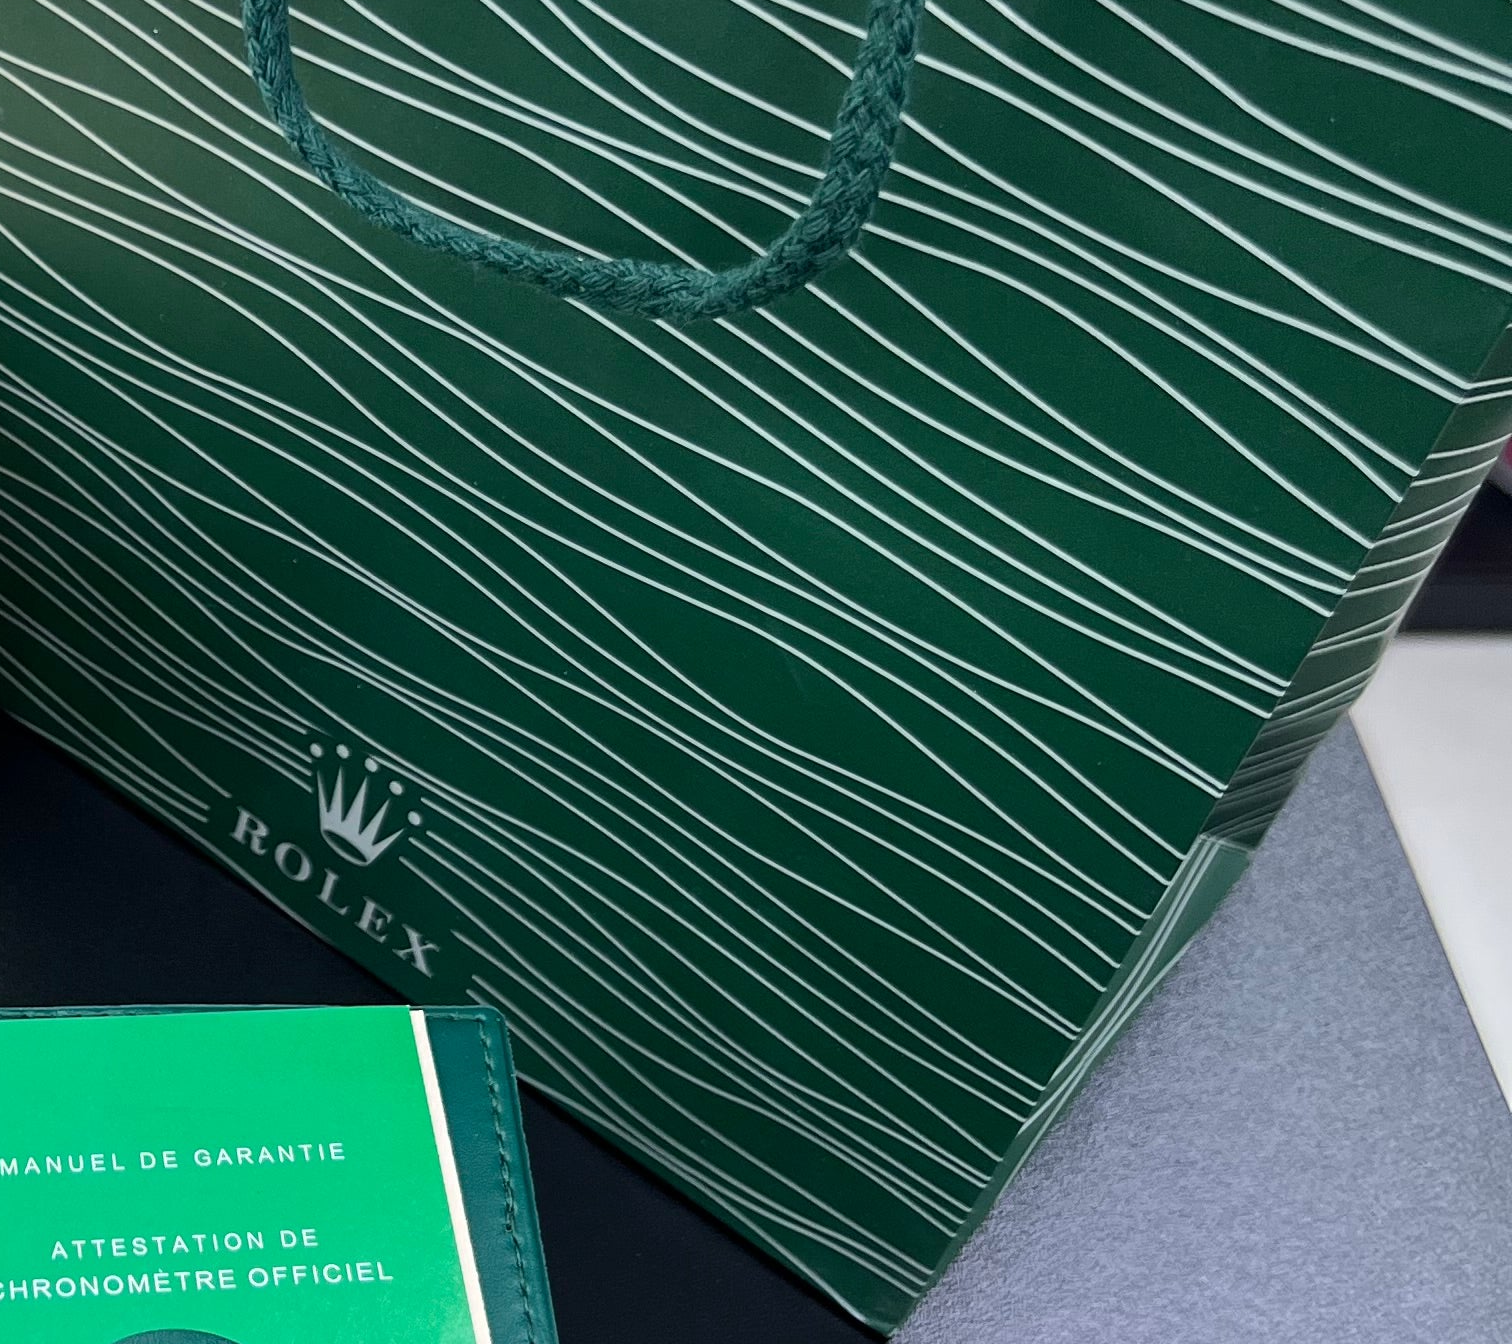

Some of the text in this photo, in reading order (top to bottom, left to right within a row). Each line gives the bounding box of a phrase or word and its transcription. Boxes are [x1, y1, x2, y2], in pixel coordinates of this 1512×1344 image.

[228, 806, 440, 979] ROLEX
[139, 1149, 178, 1171] DE
[193, 1142, 346, 1168] GARANTIE
[51, 1227, 319, 1260] ATTESTATION DE
[248, 1260, 394, 1288] OFFICIEL
